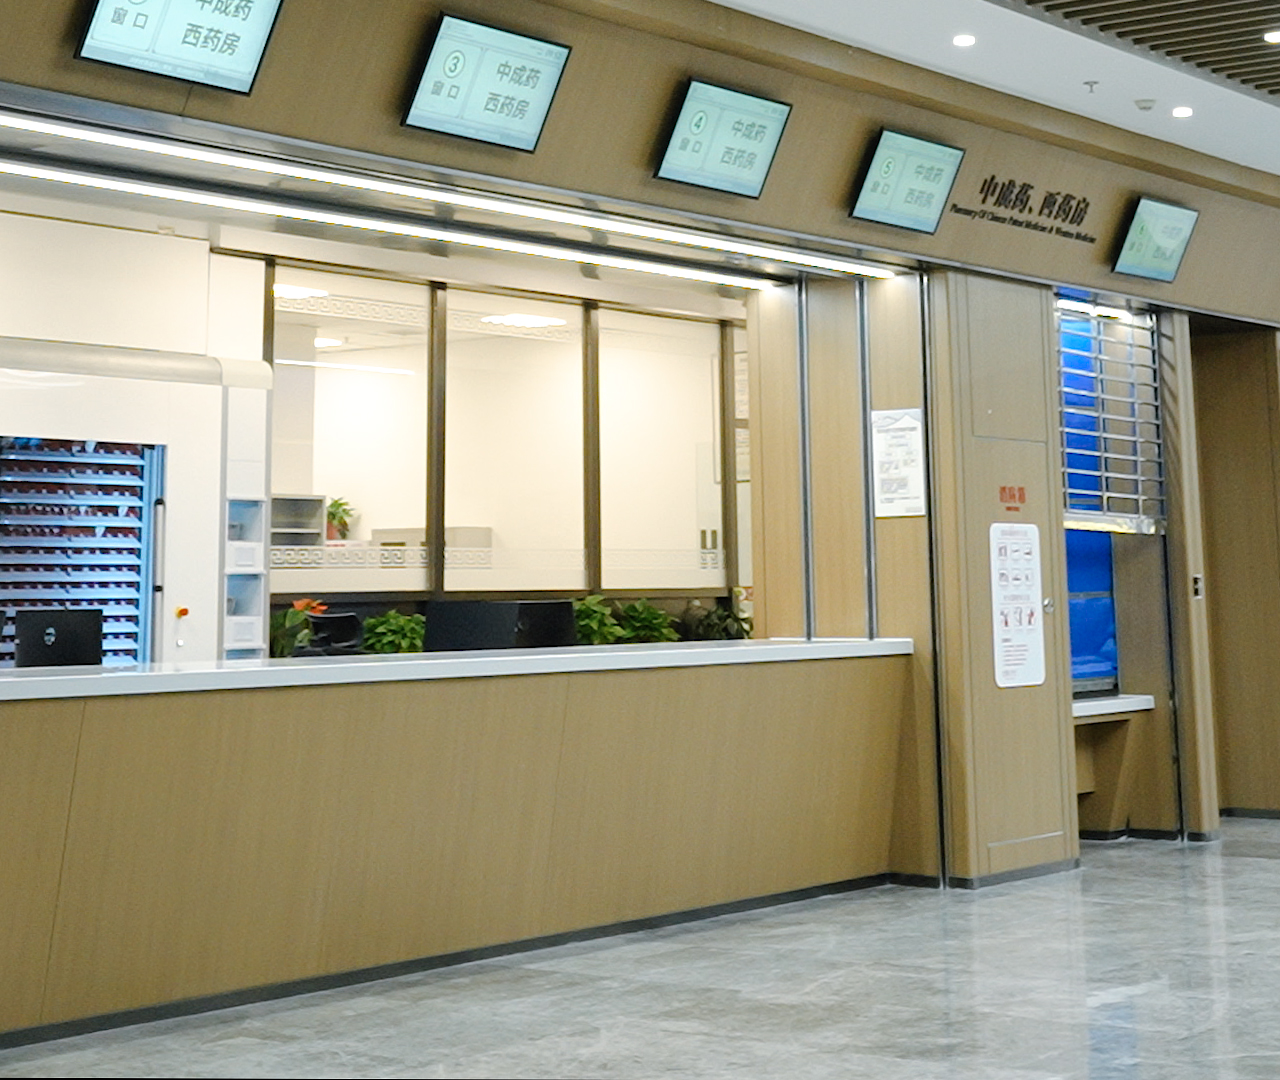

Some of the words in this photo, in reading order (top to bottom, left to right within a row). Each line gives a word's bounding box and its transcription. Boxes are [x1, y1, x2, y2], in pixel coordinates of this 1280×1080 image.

[181, 22, 241, 56] 西药房
[497, 61, 542, 90] 中成药
[483, 91, 530, 120] 西药房
